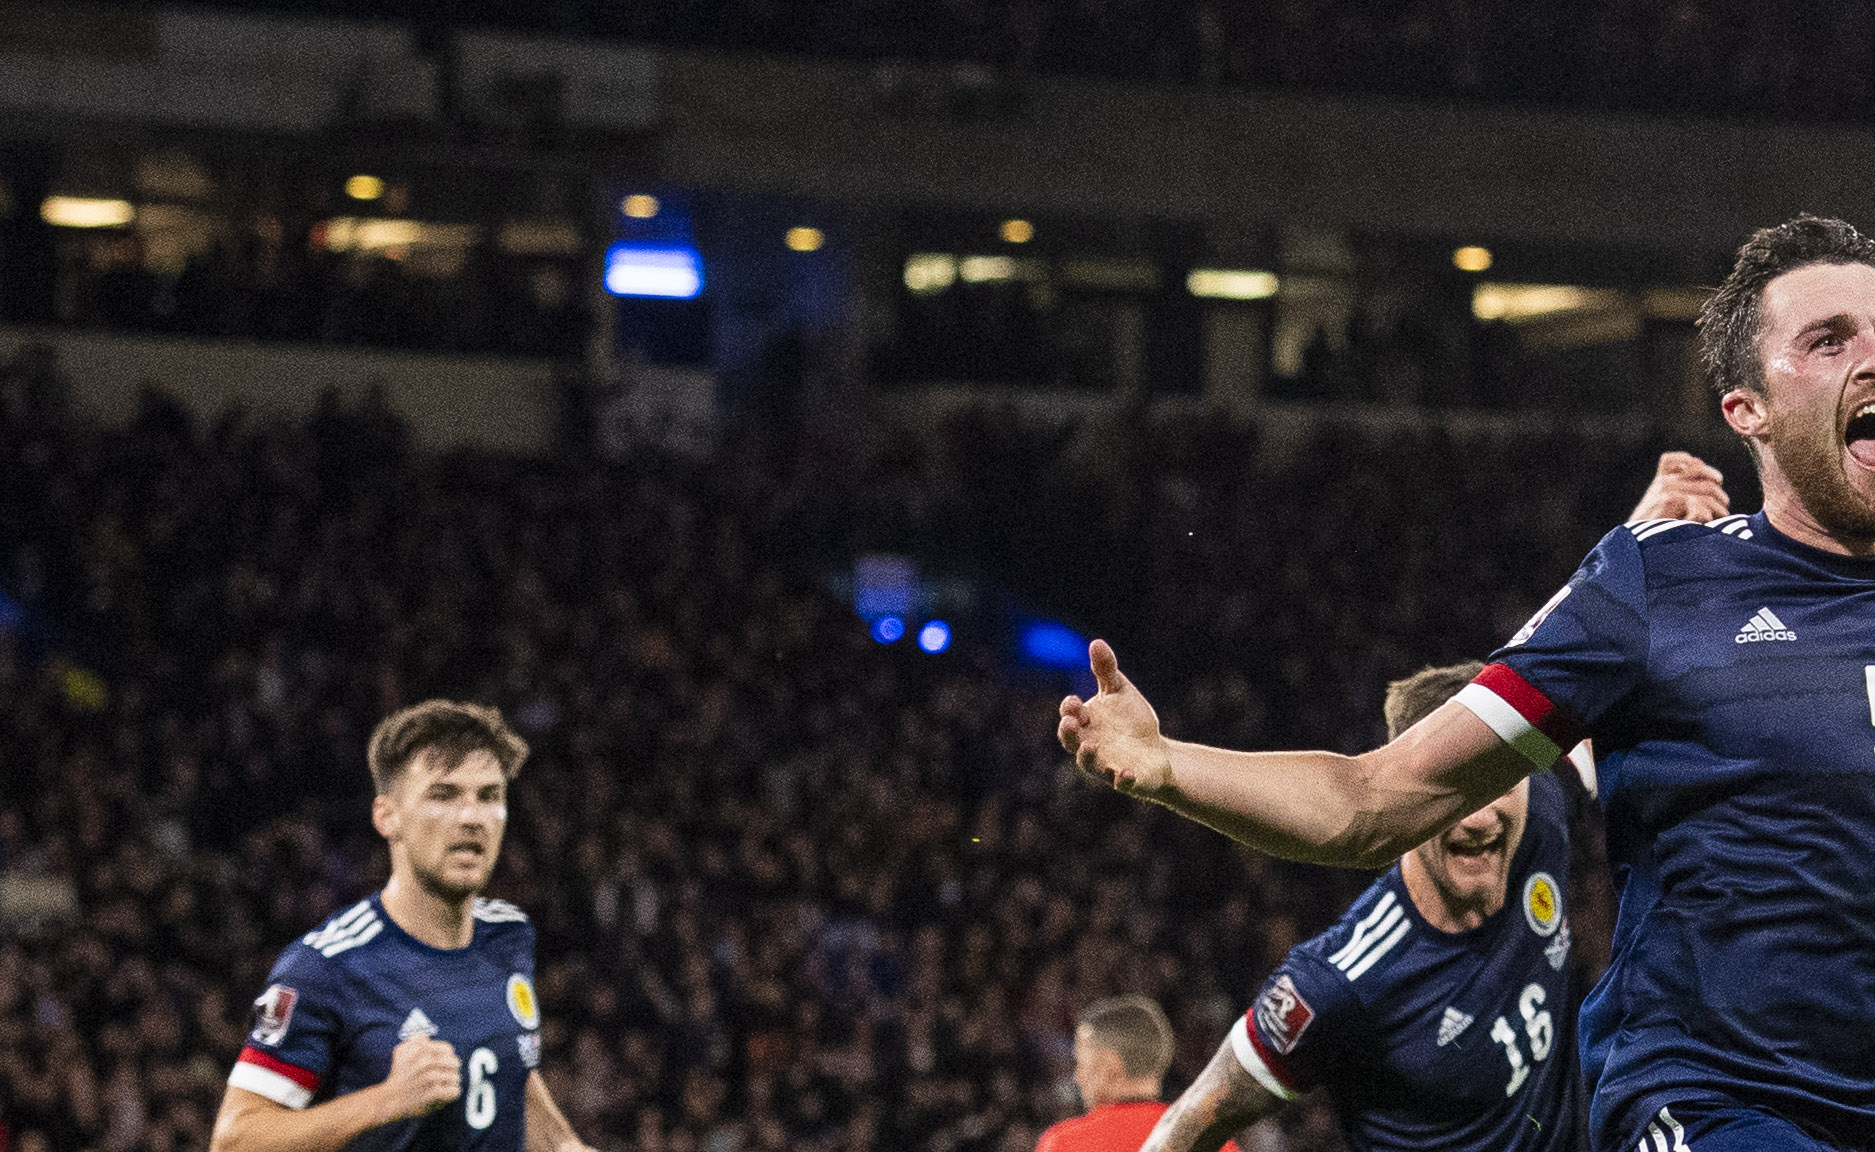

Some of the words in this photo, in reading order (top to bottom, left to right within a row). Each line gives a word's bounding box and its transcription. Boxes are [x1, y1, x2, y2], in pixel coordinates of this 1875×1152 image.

[1735, 629, 1797, 644] adidas
[1490, 983, 1553, 1097] 16
[465, 1047, 498, 1130] 6
